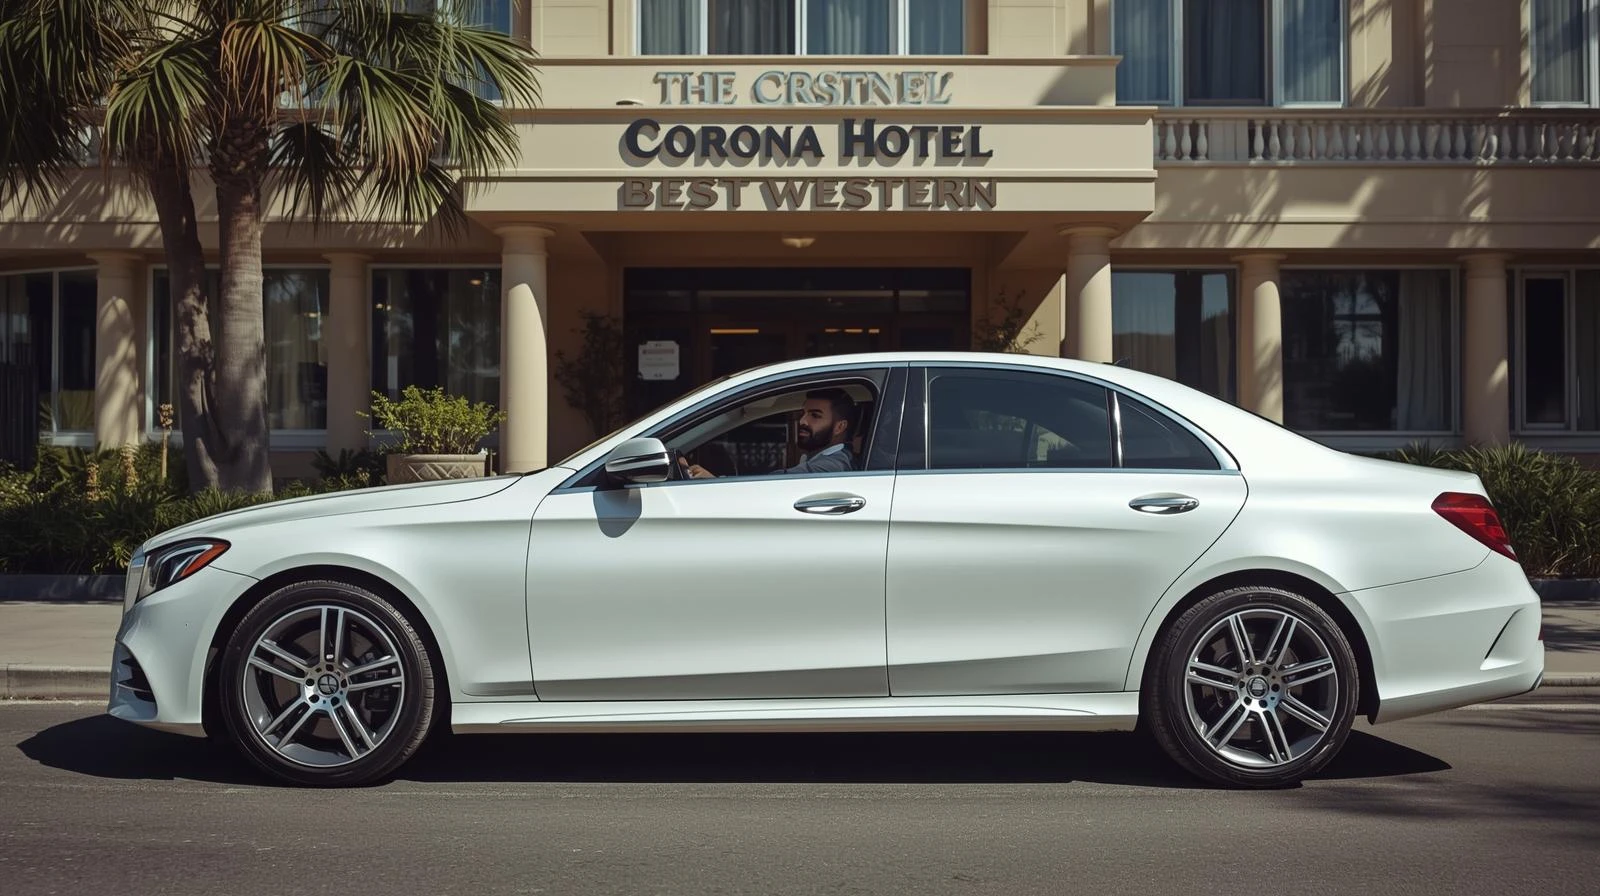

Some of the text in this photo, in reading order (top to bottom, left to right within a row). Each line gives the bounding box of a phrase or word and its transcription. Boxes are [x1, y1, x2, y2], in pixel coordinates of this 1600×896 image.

[653, 71, 737, 105] THE
[625, 118, 993, 158] CORONA HOTEL
[621, 178, 997, 209] BEST WESTERN
